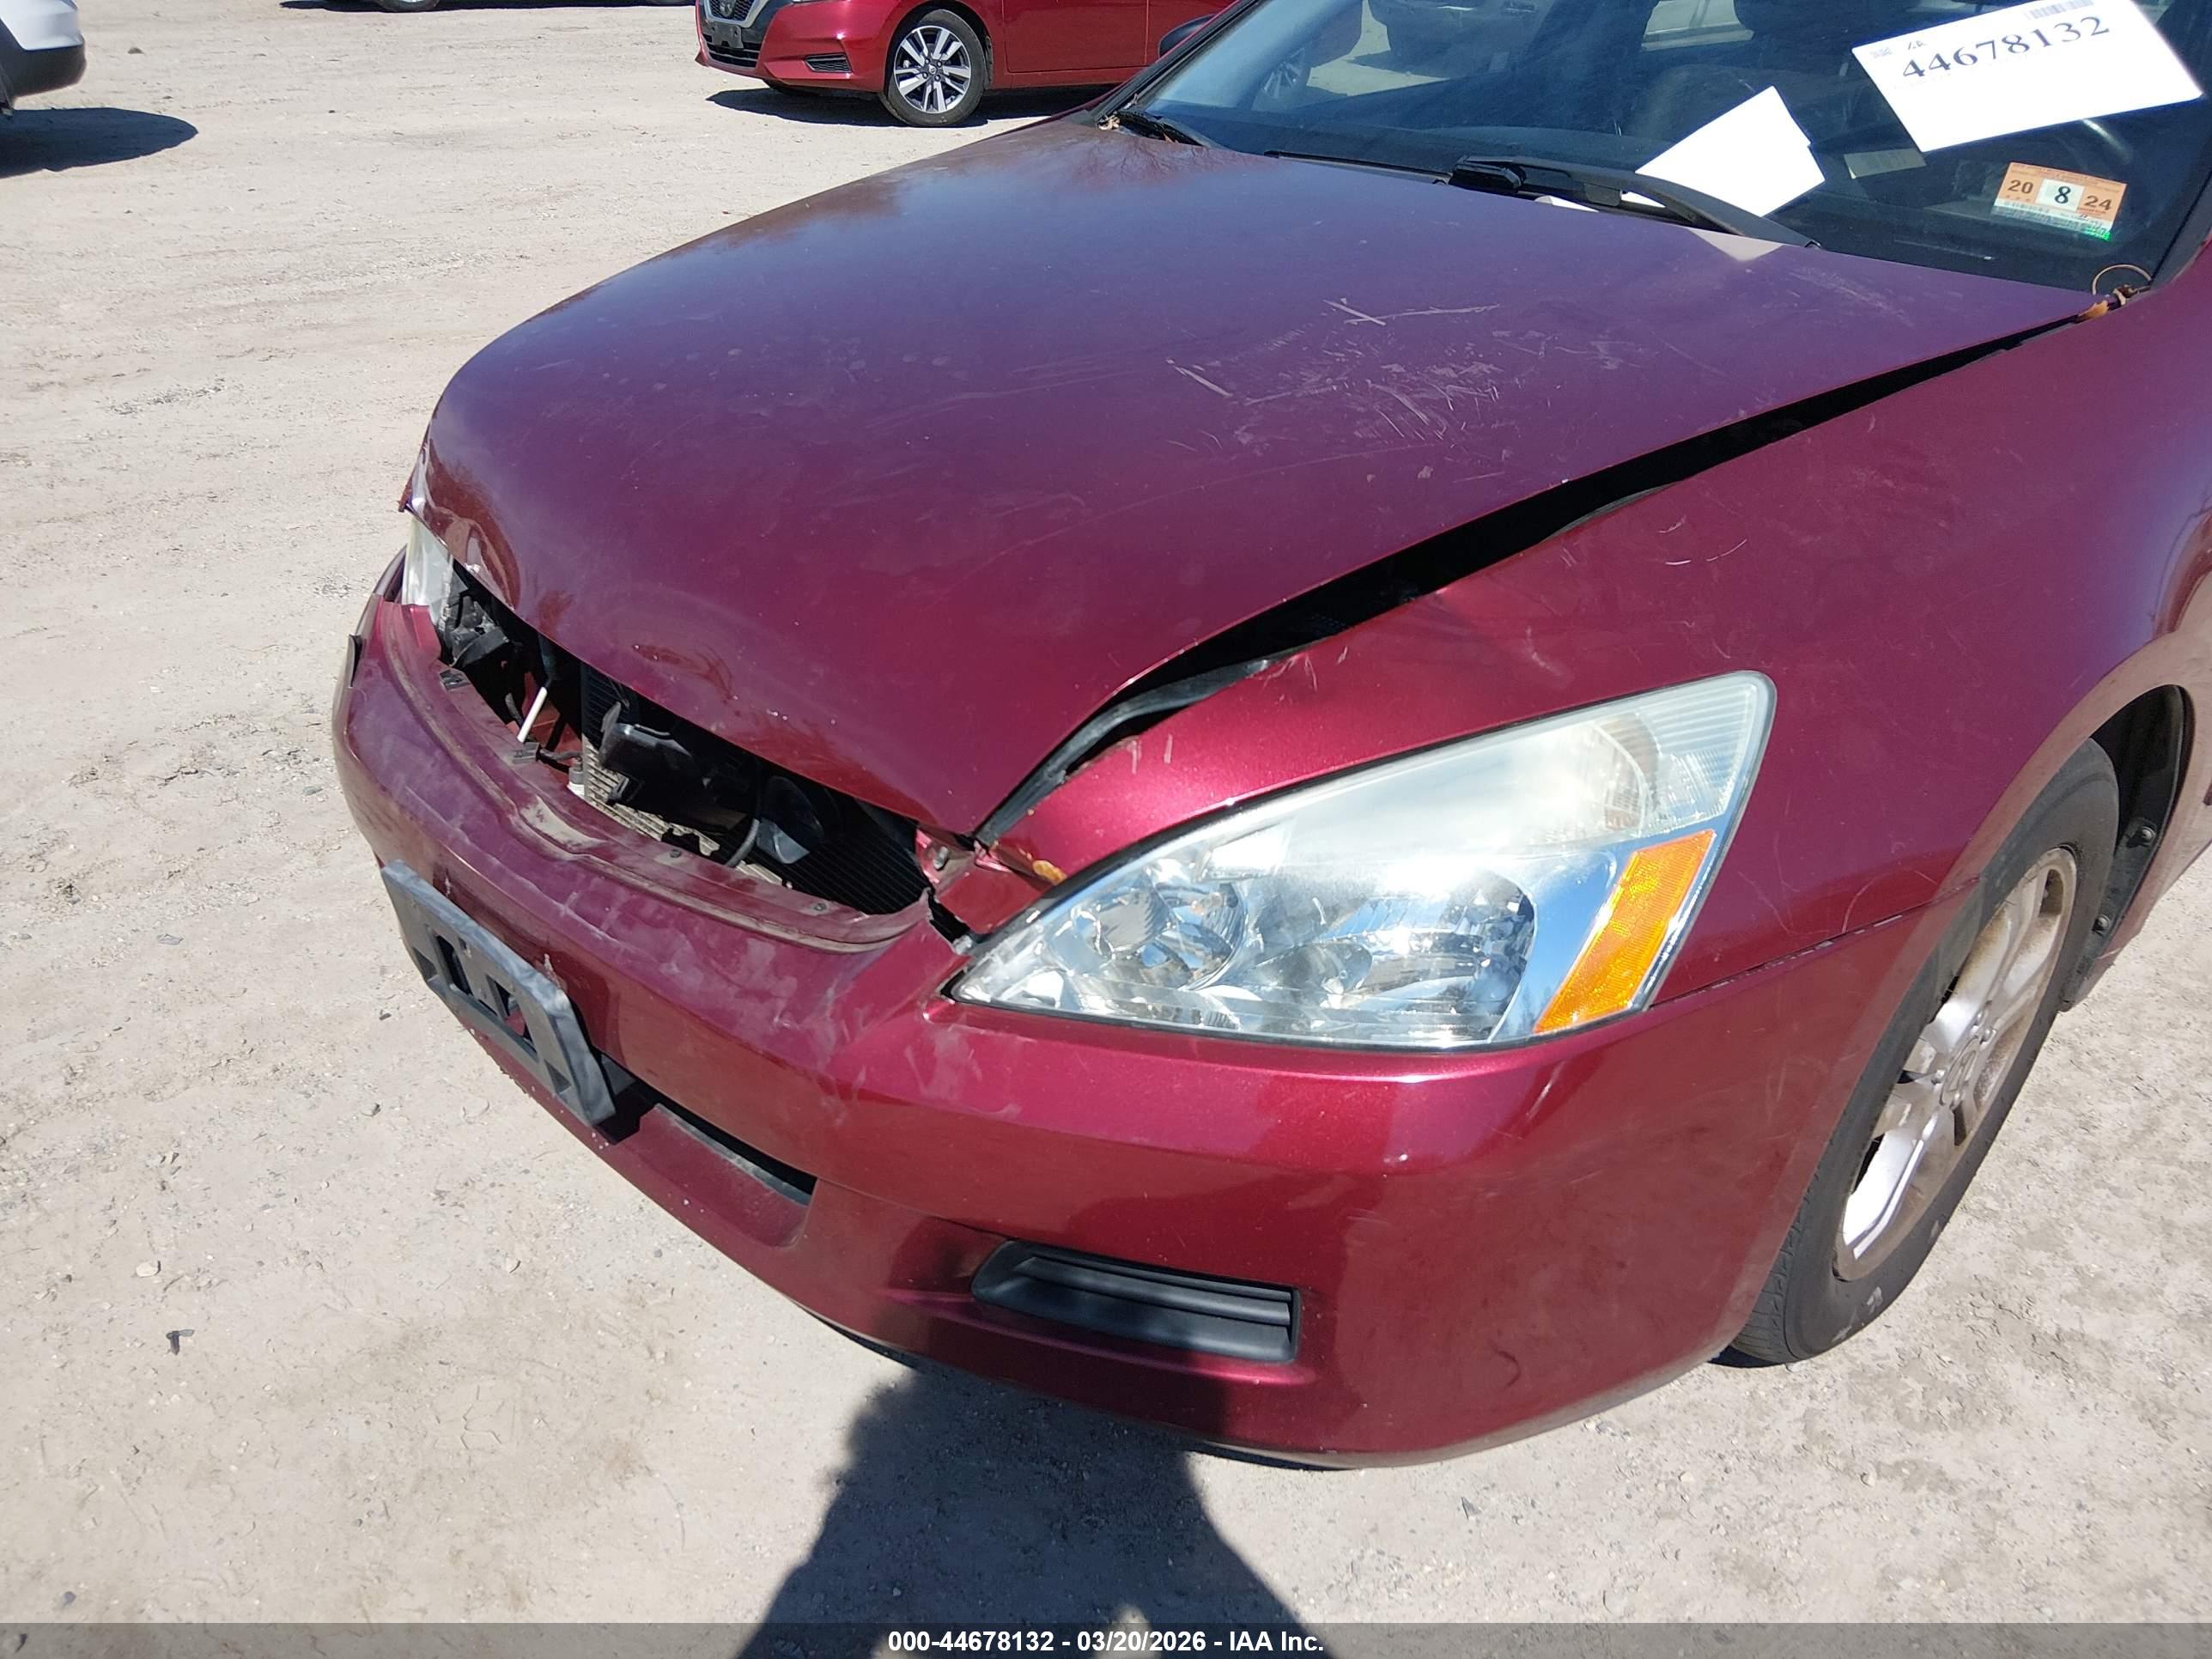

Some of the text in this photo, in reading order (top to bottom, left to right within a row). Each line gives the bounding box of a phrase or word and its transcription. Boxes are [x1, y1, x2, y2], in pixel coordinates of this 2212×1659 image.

[1902, 15, 2110, 78] 44678132
[2008, 179, 2034, 195] 20
[2054, 185, 2071, 204] 8
[2083, 195, 2112, 211] 24
